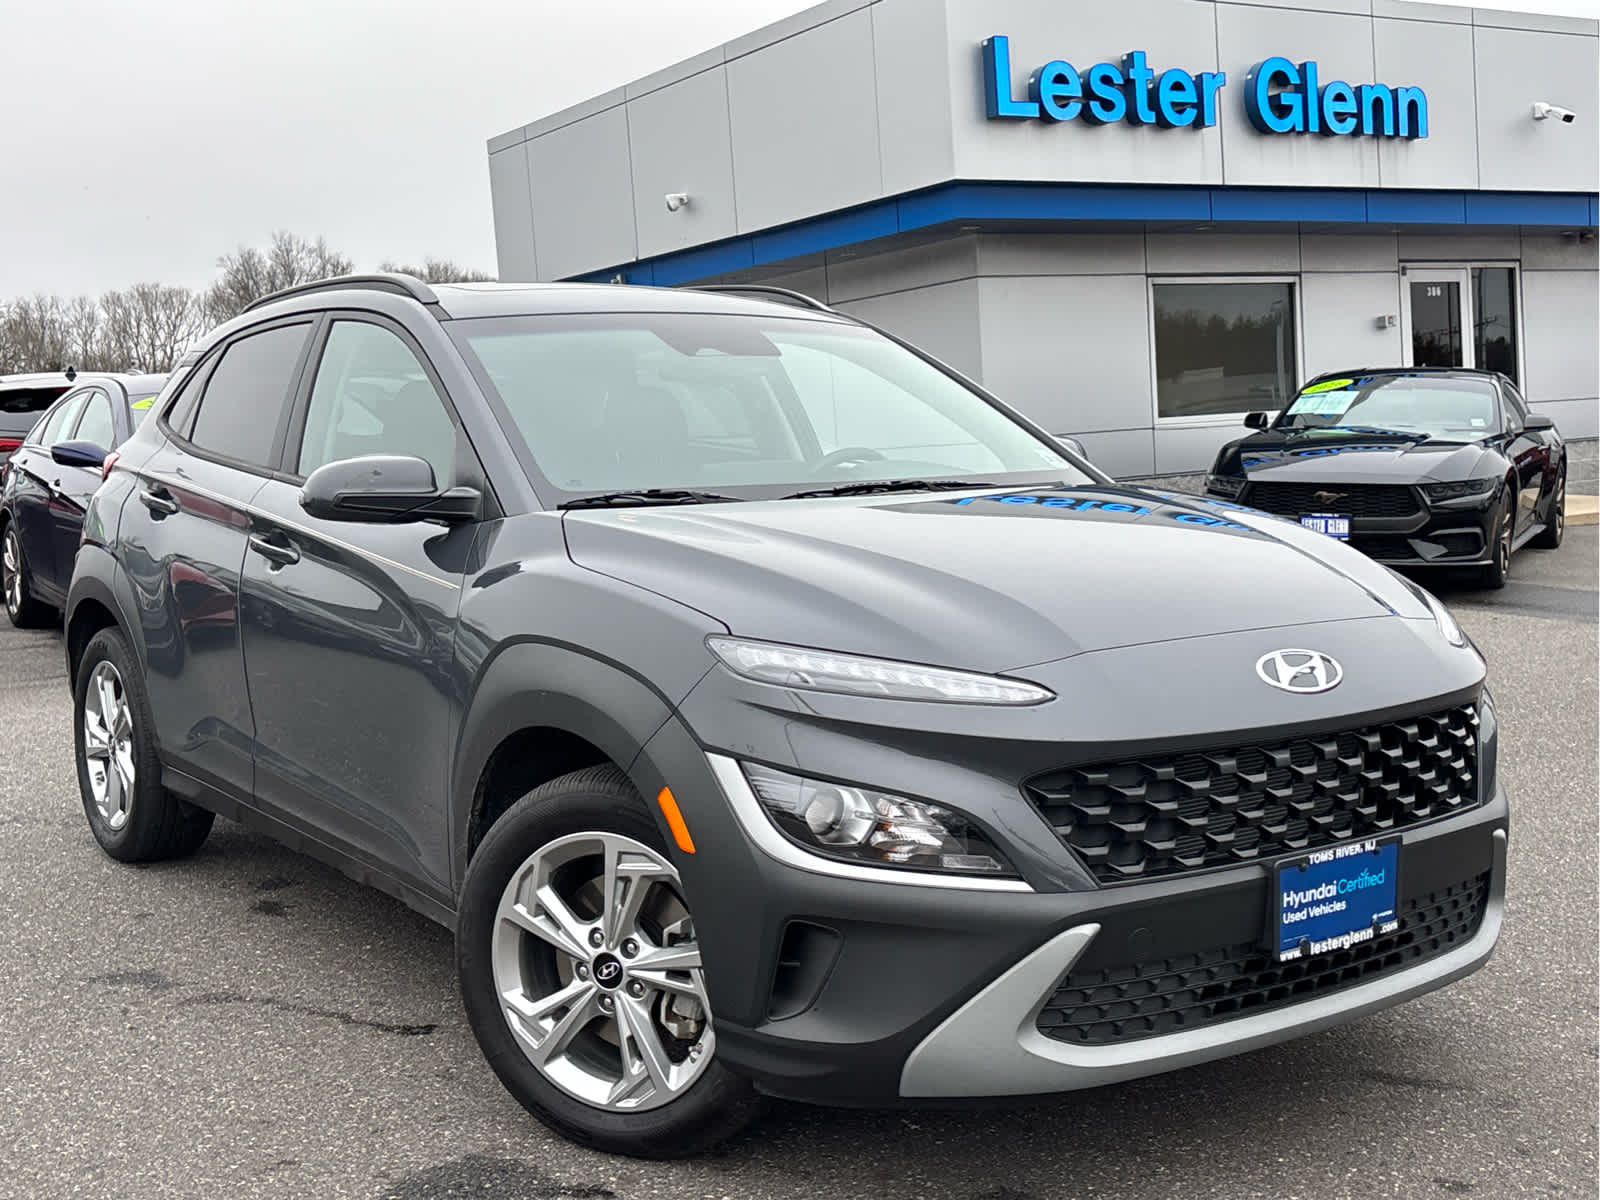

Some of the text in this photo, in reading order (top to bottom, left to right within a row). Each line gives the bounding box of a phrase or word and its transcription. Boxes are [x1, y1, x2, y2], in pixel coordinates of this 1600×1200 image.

[981, 35, 1428, 139] Lester Glenn
[1308, 850, 1334, 865] TOMS
[1365, 840, 1376, 852] NJ
[1283, 867, 1385, 909] Hyundai Certified
[1283, 899, 1347, 924] Used Vehicles
[1310, 928, 1374, 955] lesterglenn
[1379, 921, 1398, 934] .com
